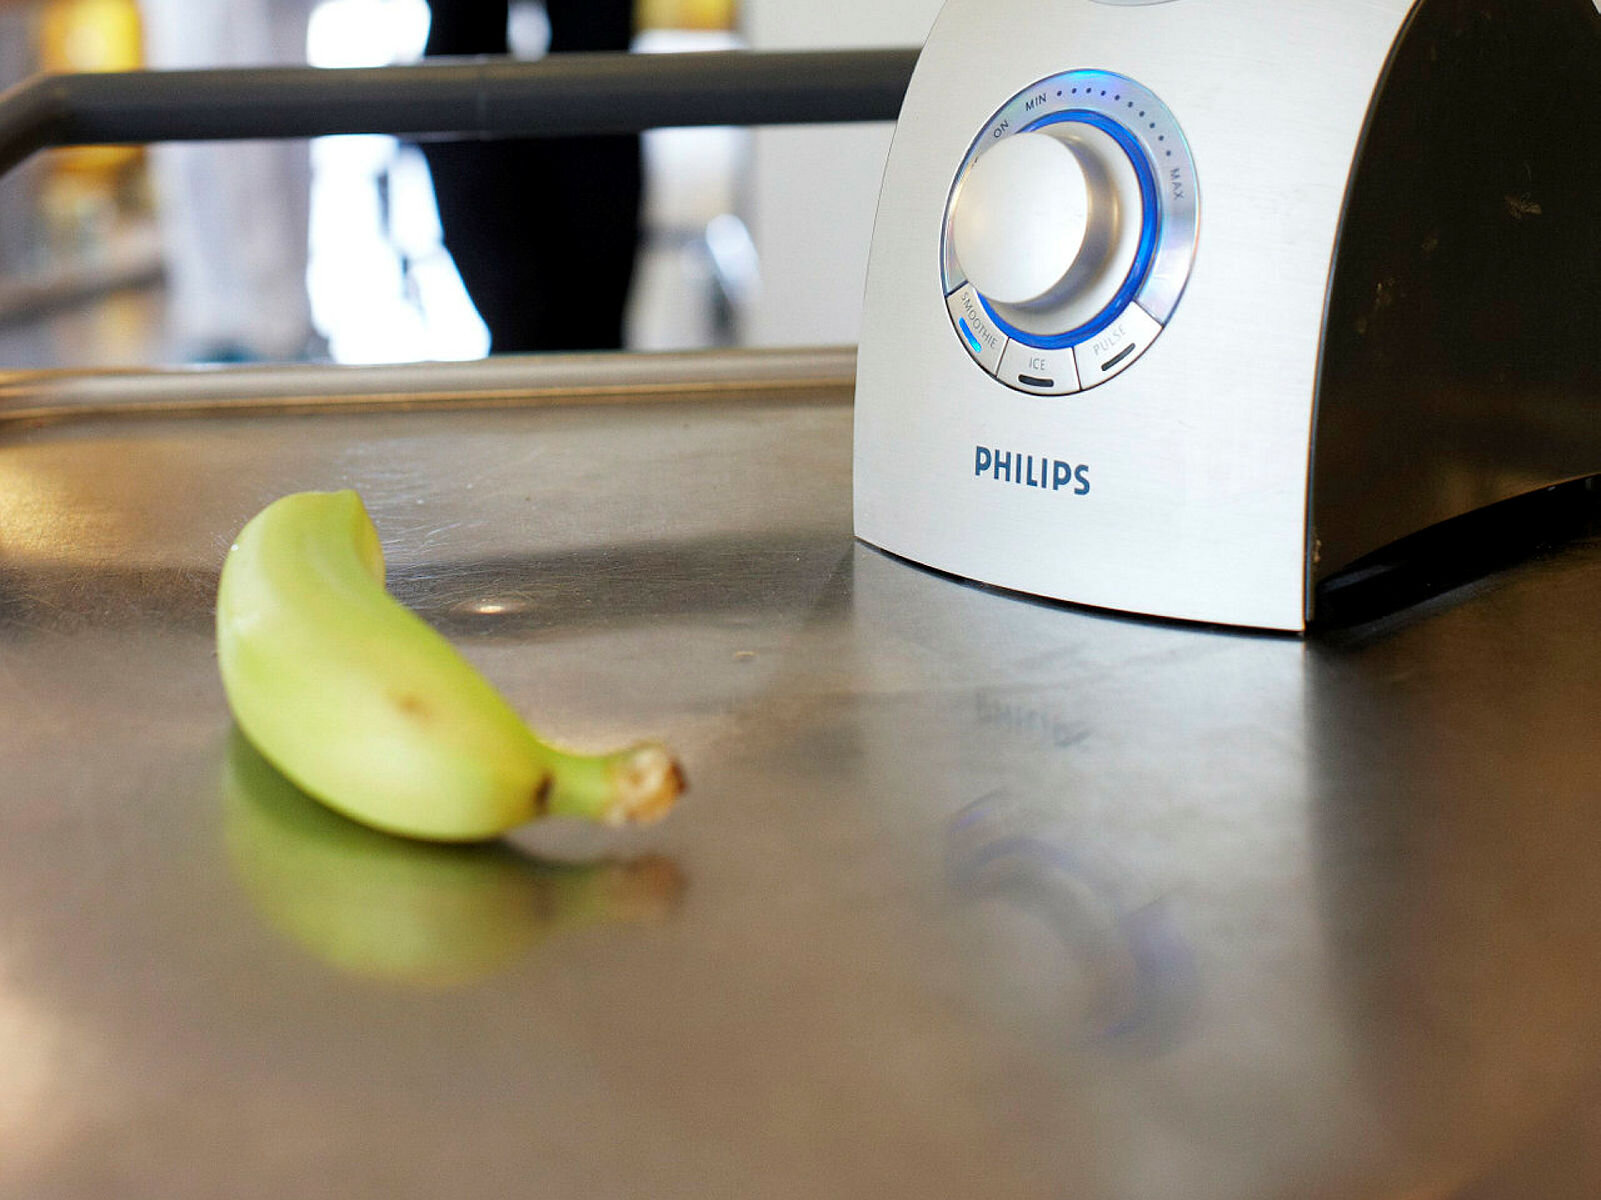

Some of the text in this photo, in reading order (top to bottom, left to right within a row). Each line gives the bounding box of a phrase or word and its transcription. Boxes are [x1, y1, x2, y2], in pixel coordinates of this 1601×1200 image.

[1025, 92, 1047, 111] MIN
[993, 119, 1009, 138] ON
[1170, 167, 1184, 200] MAX
[961, 291, 998, 349] SMOOTHIE
[1093, 325, 1126, 356] PULSE
[1028, 356, 1046, 371] ICE
[974, 445, 1090, 496] PHILIPS
